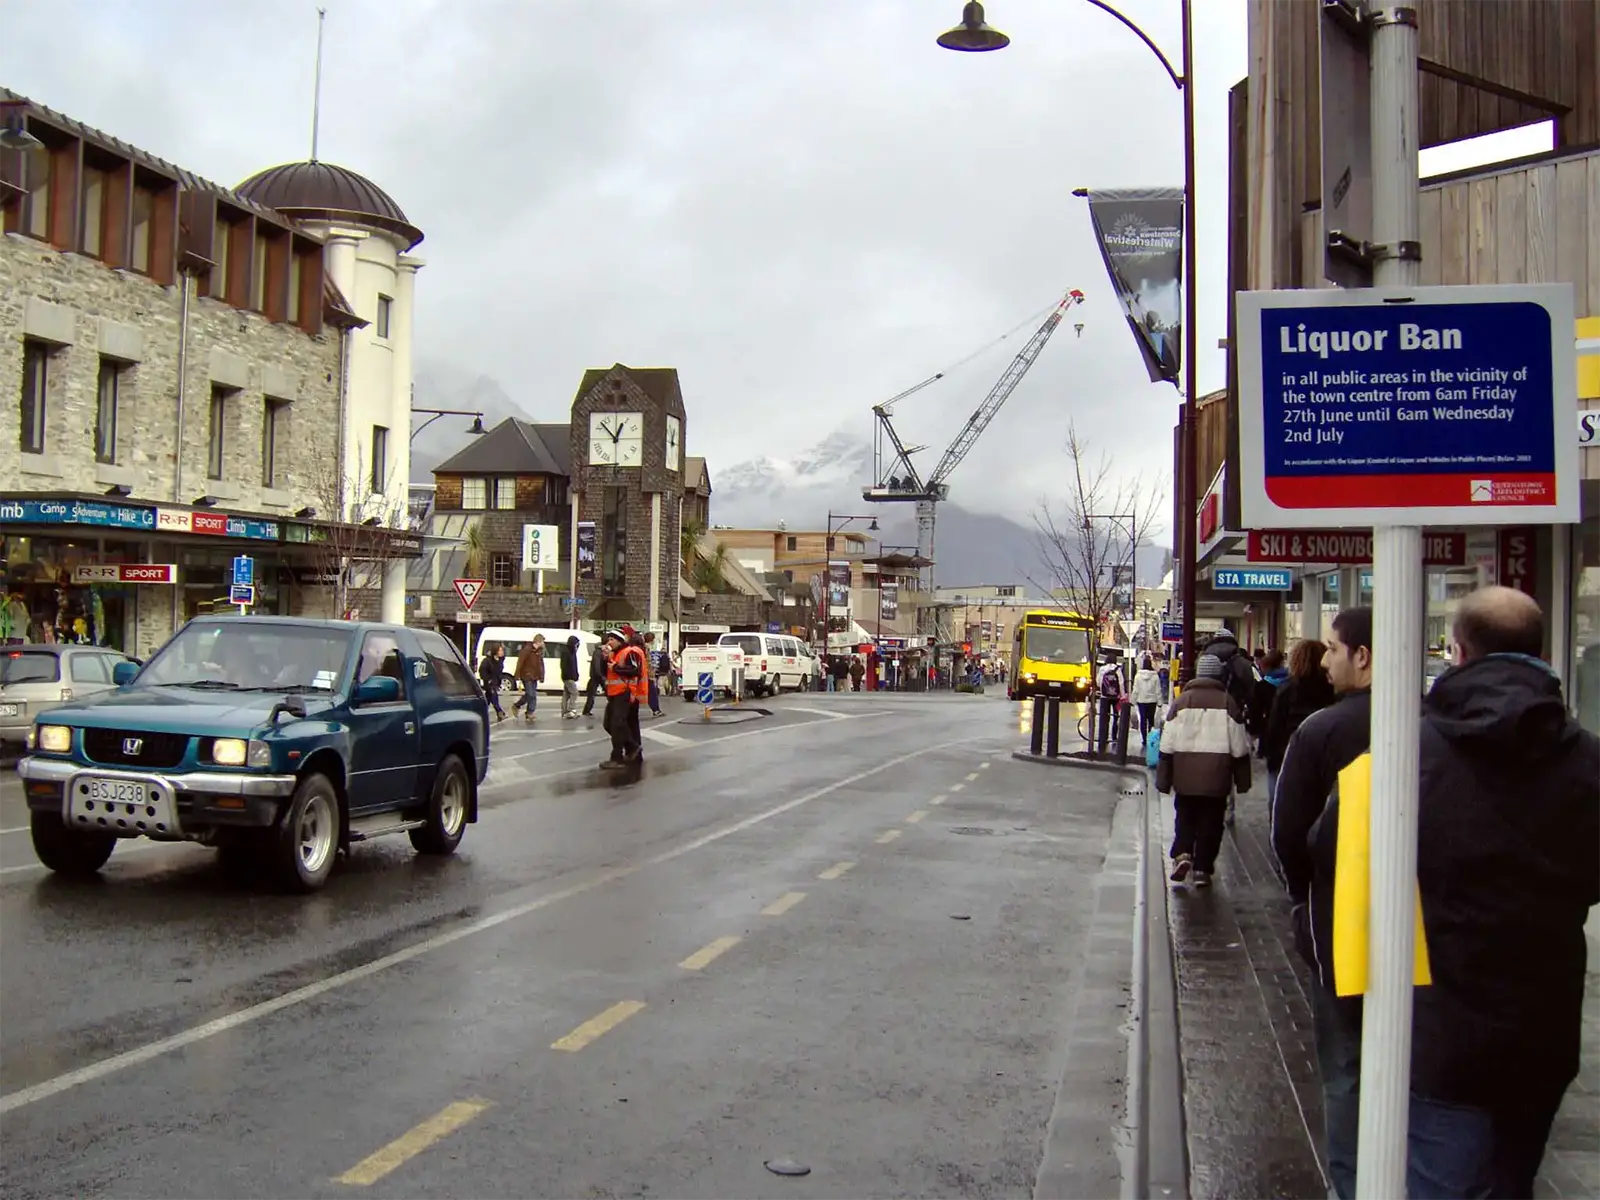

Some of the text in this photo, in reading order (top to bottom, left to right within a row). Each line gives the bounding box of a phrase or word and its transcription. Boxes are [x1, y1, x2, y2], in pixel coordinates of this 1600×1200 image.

[1280, 323, 1462, 359] Liquor Ban
[1282, 366, 1528, 388] in all public areas in the vicinity of
[1282, 385, 1518, 404] the town centre from 6am Friday
[1283, 404, 1515, 425] 27th June until 6am Wednesday
[1284, 427, 1344, 444] 2nd July
[1579, 414, 1600, 442] S
[40, 502, 67, 516] Camp
[118, 509, 136, 523] Hike
[195, 517, 224, 529] SPORT
[1260, 535, 1286, 557] SKI
[1292, 537, 1303, 557] &
[125, 569, 164, 578] SPORT
[1217, 573, 1288, 586] STA TRAVEL
[91, 782, 144, 802] BSJ238
